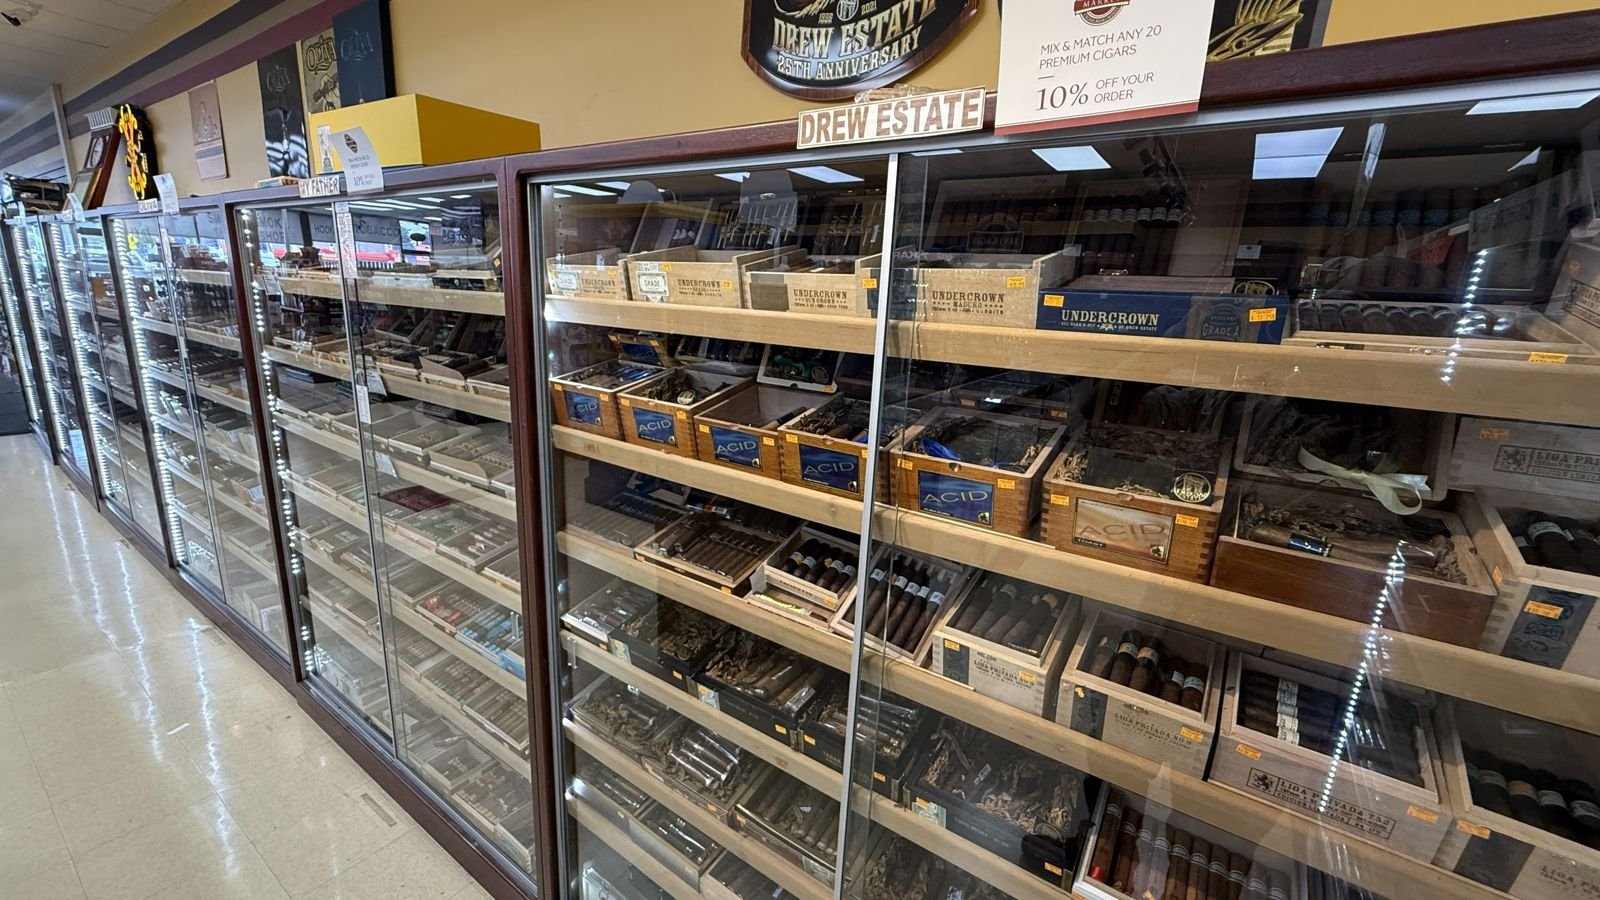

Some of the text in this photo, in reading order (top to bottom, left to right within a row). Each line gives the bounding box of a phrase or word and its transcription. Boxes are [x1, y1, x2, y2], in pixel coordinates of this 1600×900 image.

[861, 0, 877, 15] 2021
[772, 0, 938, 59] DREW ESTATE
[1040, 24, 1162, 56] MIX & MATCH ANY 20
[777, 25, 923, 81] 25TH ANNIVERSARY
[1039, 44, 1137, 70] PREMIUM CIGARS
[1095, 72, 1154, 90] OFF YOUR
[1034, 82, 1089, 111] 10%
[1094, 89, 1134, 104] ORDER
[800, 91, 982, 146] DREW ESTATE
[299, 177, 339, 198] MY FATHER
[643, 279, 661, 287] SHADE
[677, 279, 721, 288] UNDERCROWN
[793, 289, 847, 300] UNDERCROWN
[931, 290, 1005, 304] UNDERCROWN
[953, 301, 982, 309] MADURO
[1061, 309, 1160, 327] UNDERCROWN
[1202, 323, 1240, 339] GRADE A
[638, 419, 672, 433] ACID
[716, 440, 757, 454] ACID
[1536, 452, 1569, 465] LIGA
[803, 461, 855, 475] ACID
[923, 489, 989, 504] ACID
[1079, 522, 1166, 538] ACID
[1277, 792, 1307, 807] EDICION
[1280, 780, 1307, 796] LIGA
[1312, 792, 1364, 817] PIVADA
[1367, 813, 1391, 826] T52
